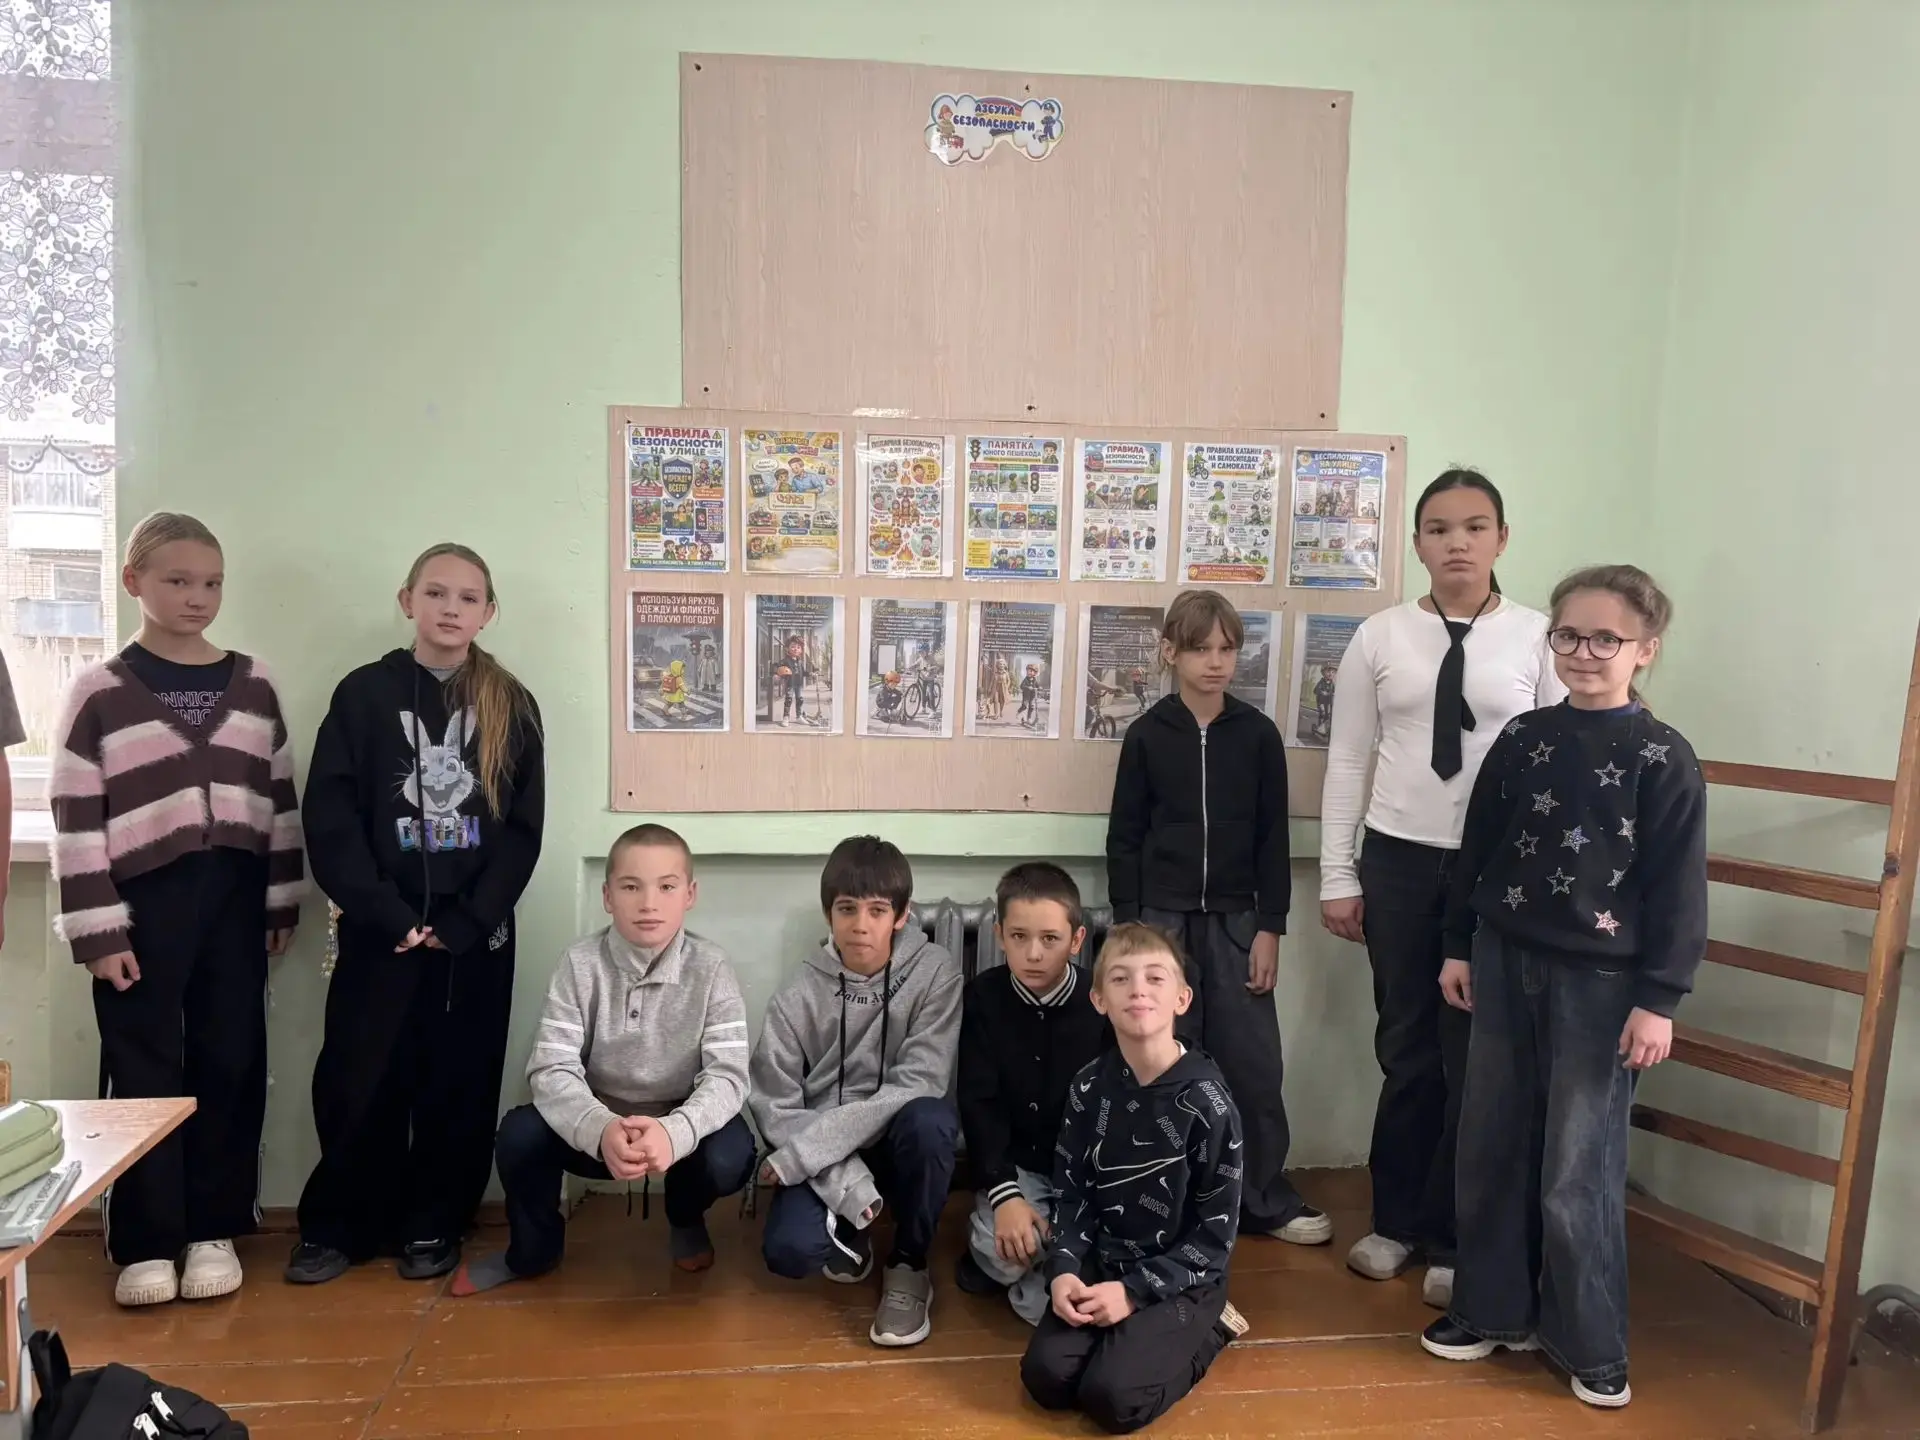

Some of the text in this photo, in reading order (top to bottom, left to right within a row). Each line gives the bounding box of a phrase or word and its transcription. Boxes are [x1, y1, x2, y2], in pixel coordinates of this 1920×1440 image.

[975, 103, 1015, 116] АЗБУКА
[953, 114, 1035, 132] БЕЗОПАСНОСТИ
[644, 427, 711, 439] ПРАВИЛА
[631, 437, 723, 448] БЕЗОПАСНОСТИ
[988, 440, 1034, 450] ПАМЯТКА
[650, 447, 666, 455] НА
[669, 447, 706, 456] УЛИЦЕ
[1007, 449, 1042, 458] ПЕШЕХОДА
[1107, 445, 1144, 454] ПРАВИЛА
[1206, 446, 1262, 455] ПРАВИЛА КАТАНИЯ
[1219, 455, 1259, 463] ВЕЛОСИПЕДАХ
[1217, 462, 1256, 470] САМОКАТАХ
[640, 595, 716, 605] ИСПОЛЬЗУЙ ЯРКУЮ
[636, 604, 671, 613] ОДЕЖДУ
[679, 605, 720, 615] ФЛИКЕРЫ
[647, 614, 681, 624] ПЛОХУЮ
[682, 615, 716, 625] ПОГОДУ!
[1199, 1080, 1228, 1116] NIKE
[1095, 1098, 1111, 1136] NIKE
[1156, 1116, 1184, 1149] NIKE
[1138, 1193, 1170, 1219] NIKE
[1180, 1243, 1210, 1267] NIKE
